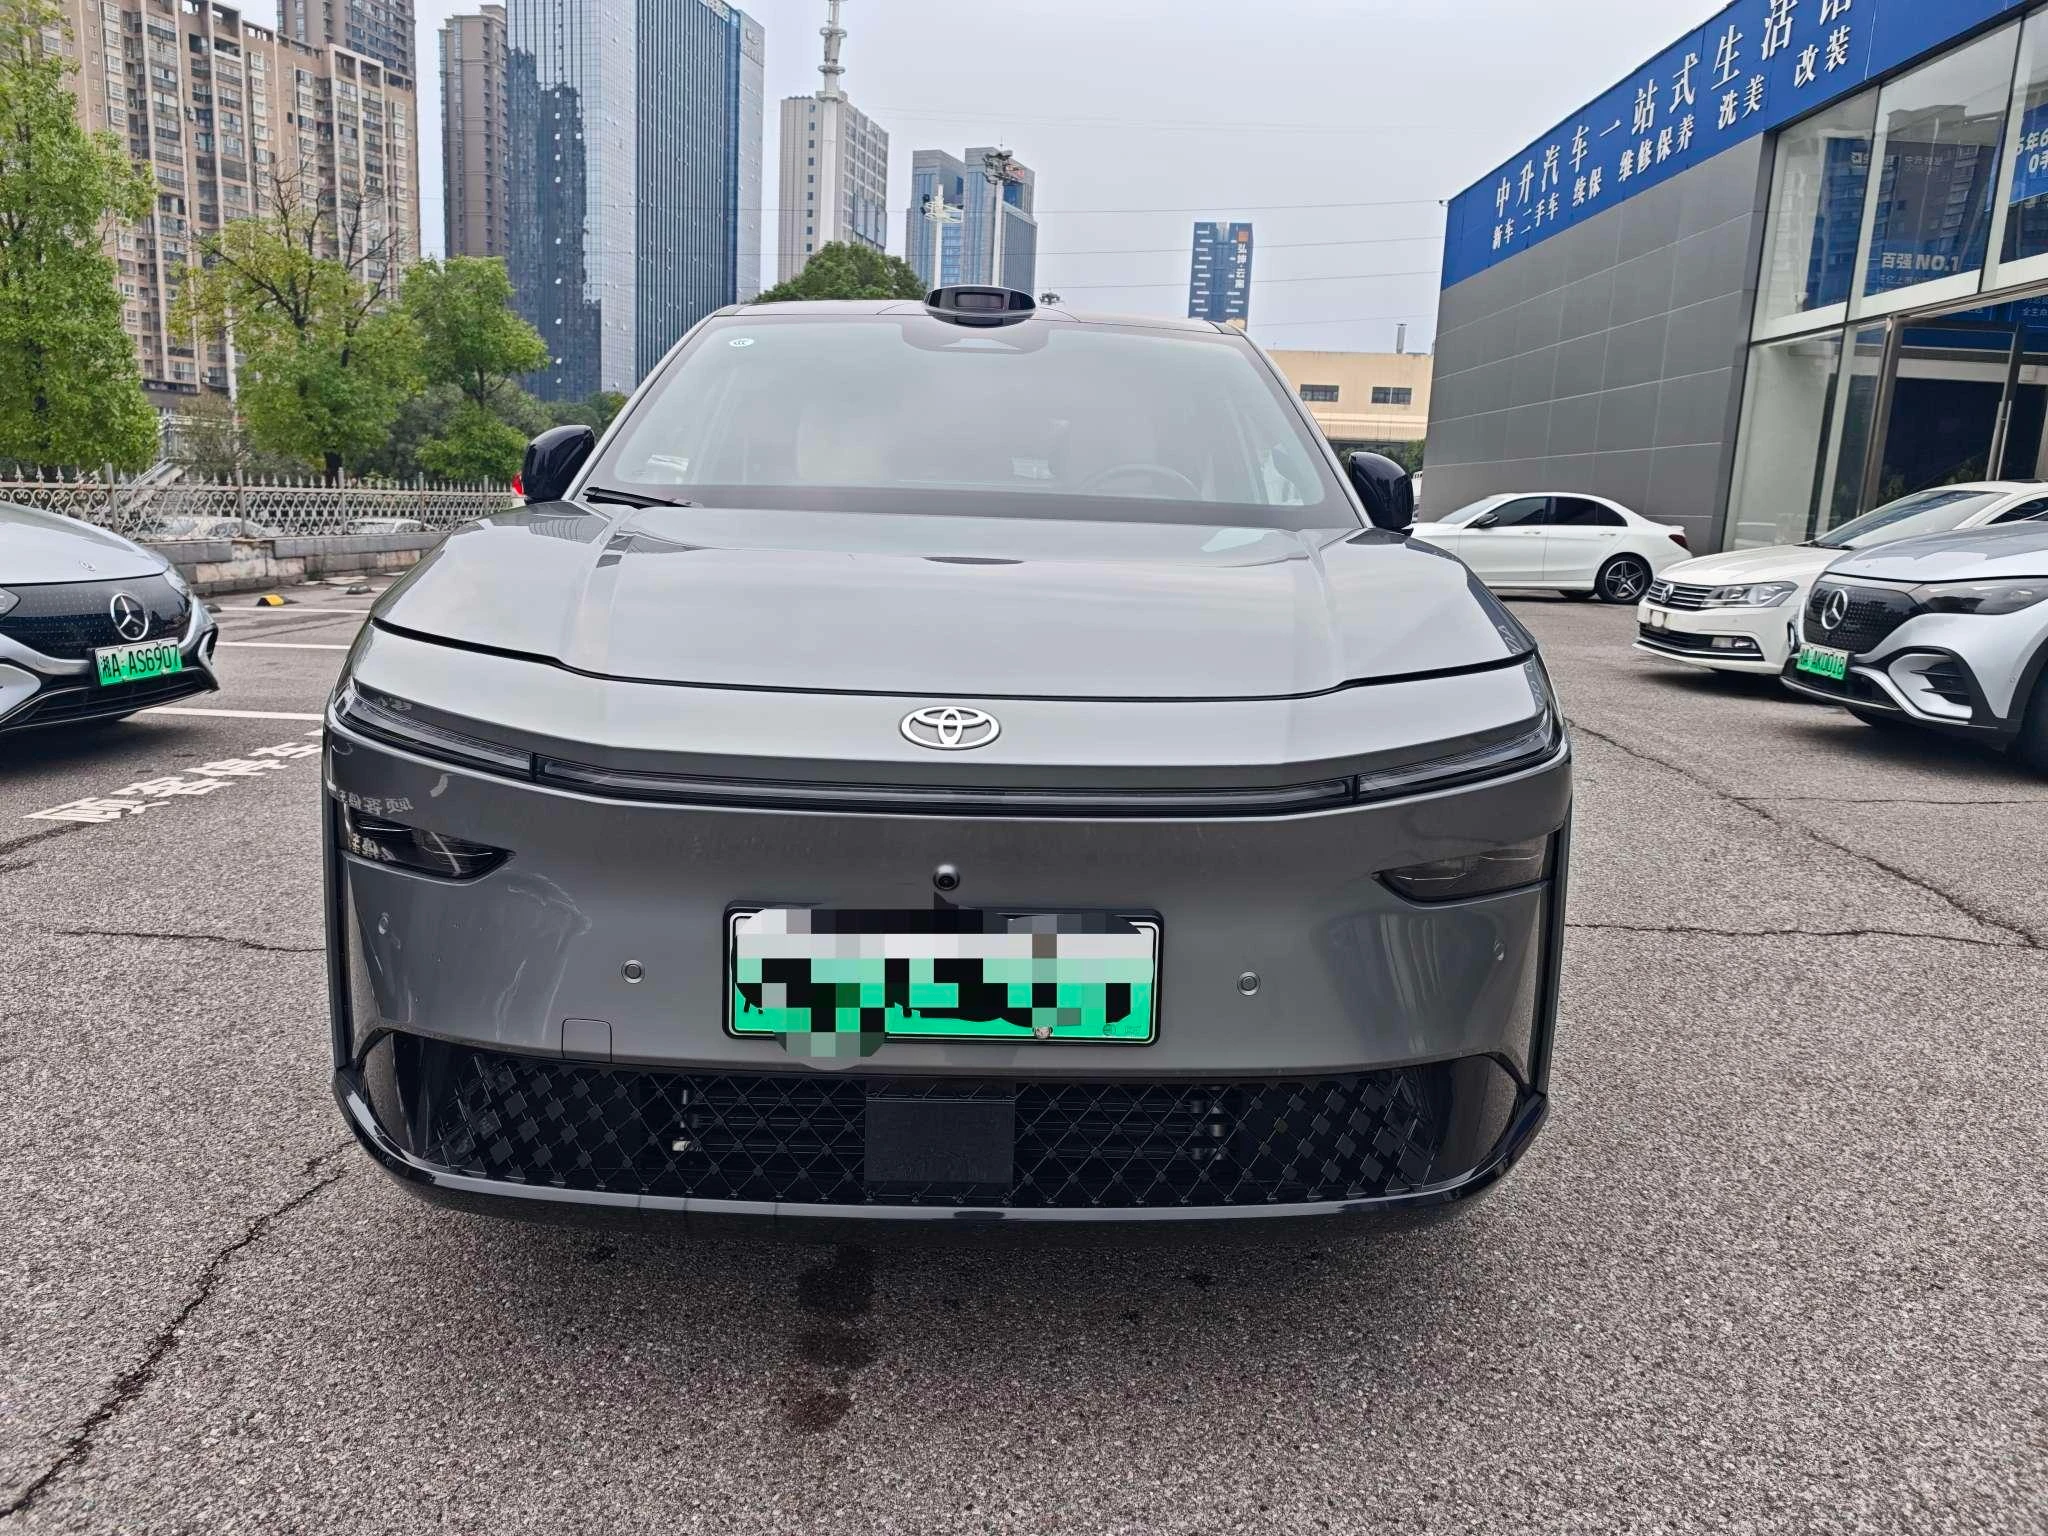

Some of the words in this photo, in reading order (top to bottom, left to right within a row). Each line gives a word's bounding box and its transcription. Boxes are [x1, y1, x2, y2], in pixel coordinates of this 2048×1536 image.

[1492, 218, 1515, 250] 新车
[1520, 192, 1560, 235] 二手车
[1572, 166, 1603, 208] 续保
[1617, 117, 1695, 183] 维修保养
[1717, 74, 1766, 130] 洗美
[1793, 24, 1851, 88] 改装
